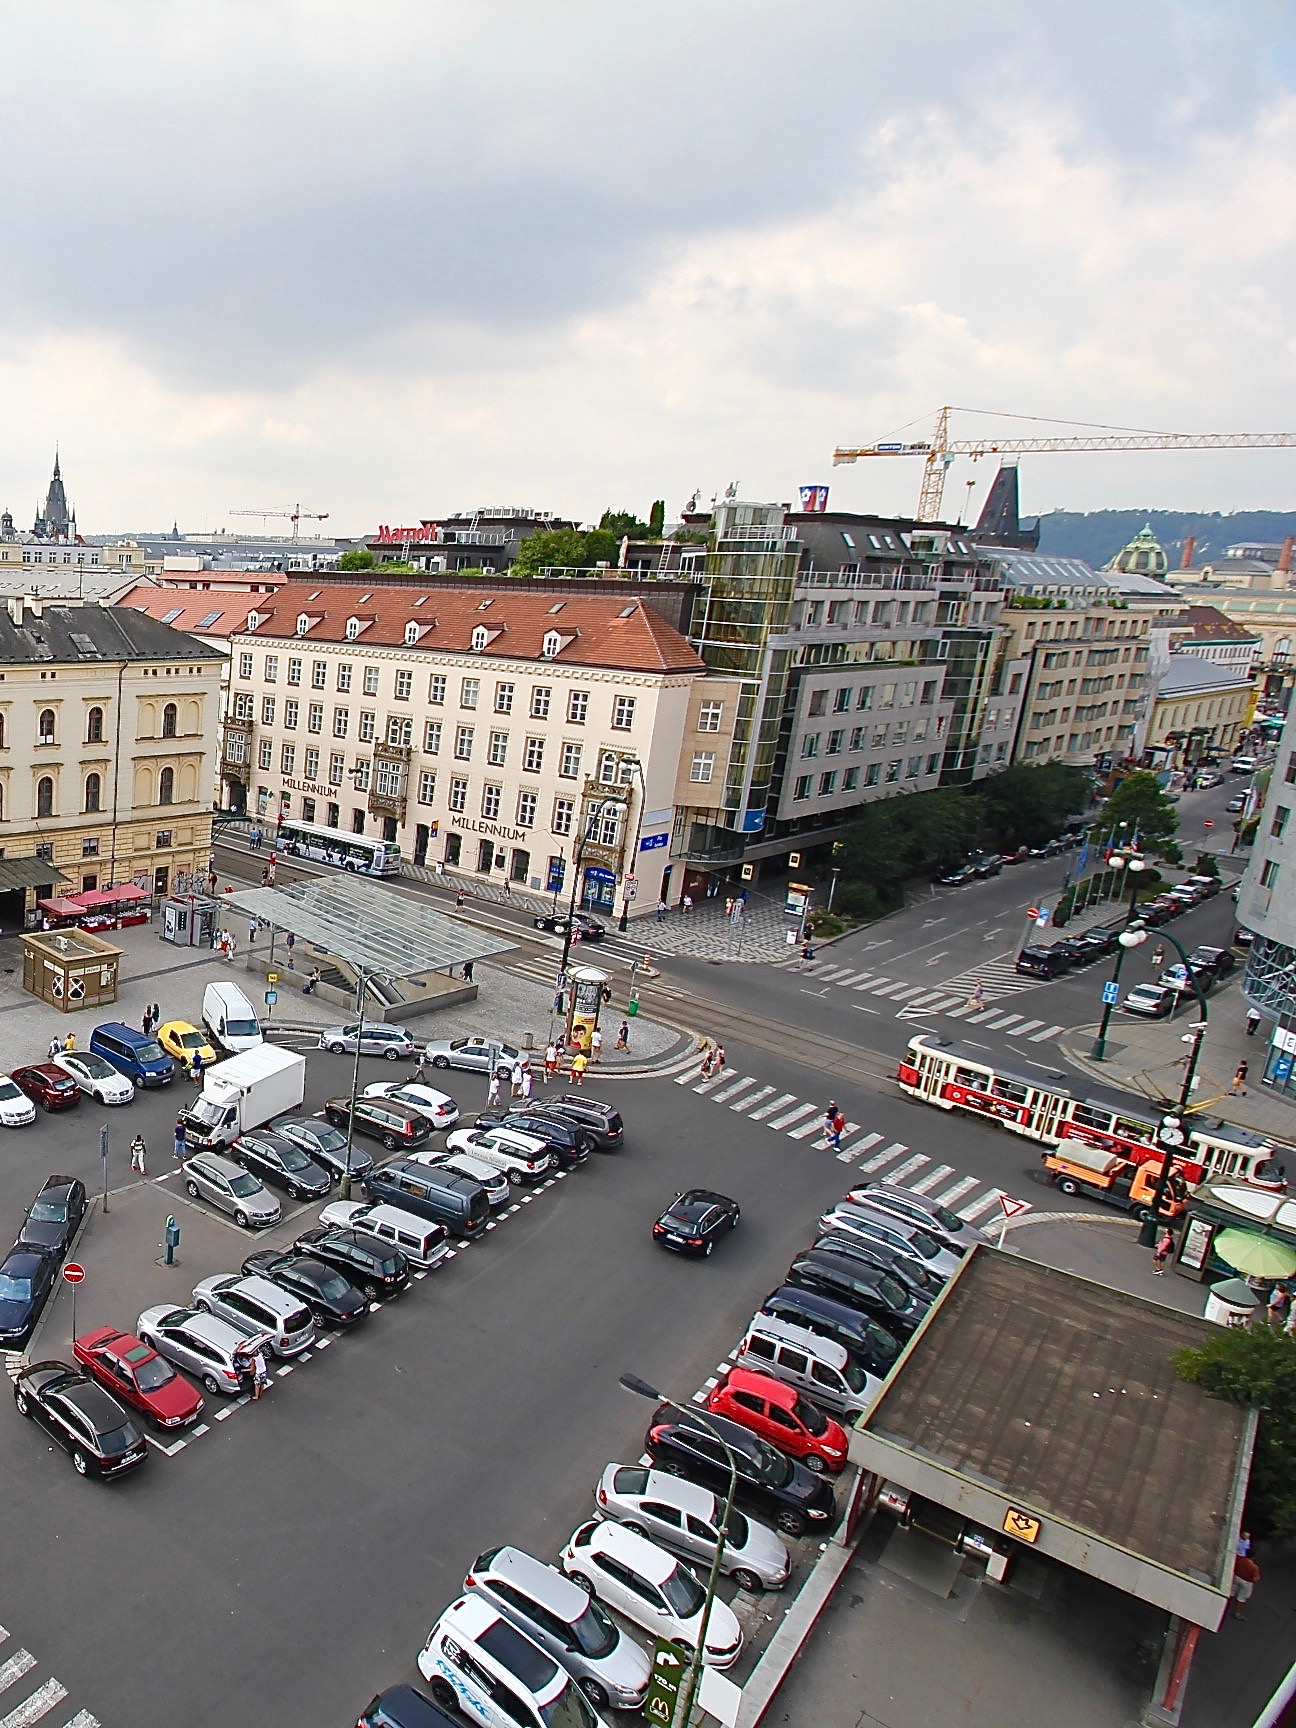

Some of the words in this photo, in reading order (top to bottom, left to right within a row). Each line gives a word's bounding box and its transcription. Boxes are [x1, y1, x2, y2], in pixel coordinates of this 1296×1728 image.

[373, 524, 438, 544] Marriott
[282, 777, 338, 798] MILLENNIUM
[451, 815, 525, 842] MILLENNIUM
